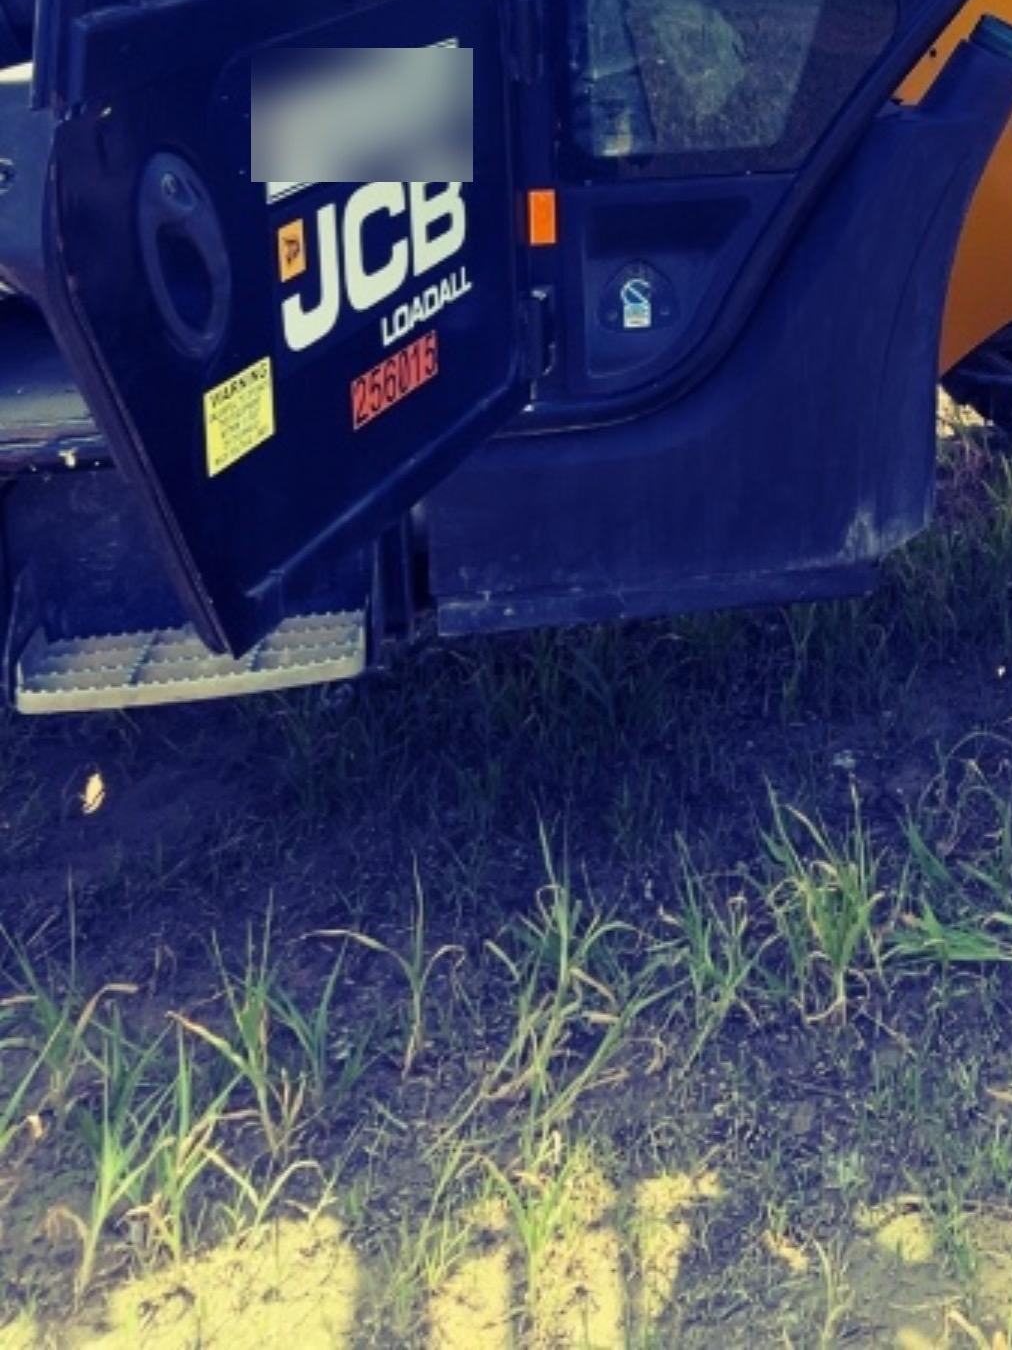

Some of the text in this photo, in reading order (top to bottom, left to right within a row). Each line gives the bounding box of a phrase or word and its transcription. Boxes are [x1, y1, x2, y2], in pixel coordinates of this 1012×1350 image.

[282, 181, 468, 352] JCB
[380, 266, 473, 348] LOADALL
[355, 333, 436, 425] 256015
